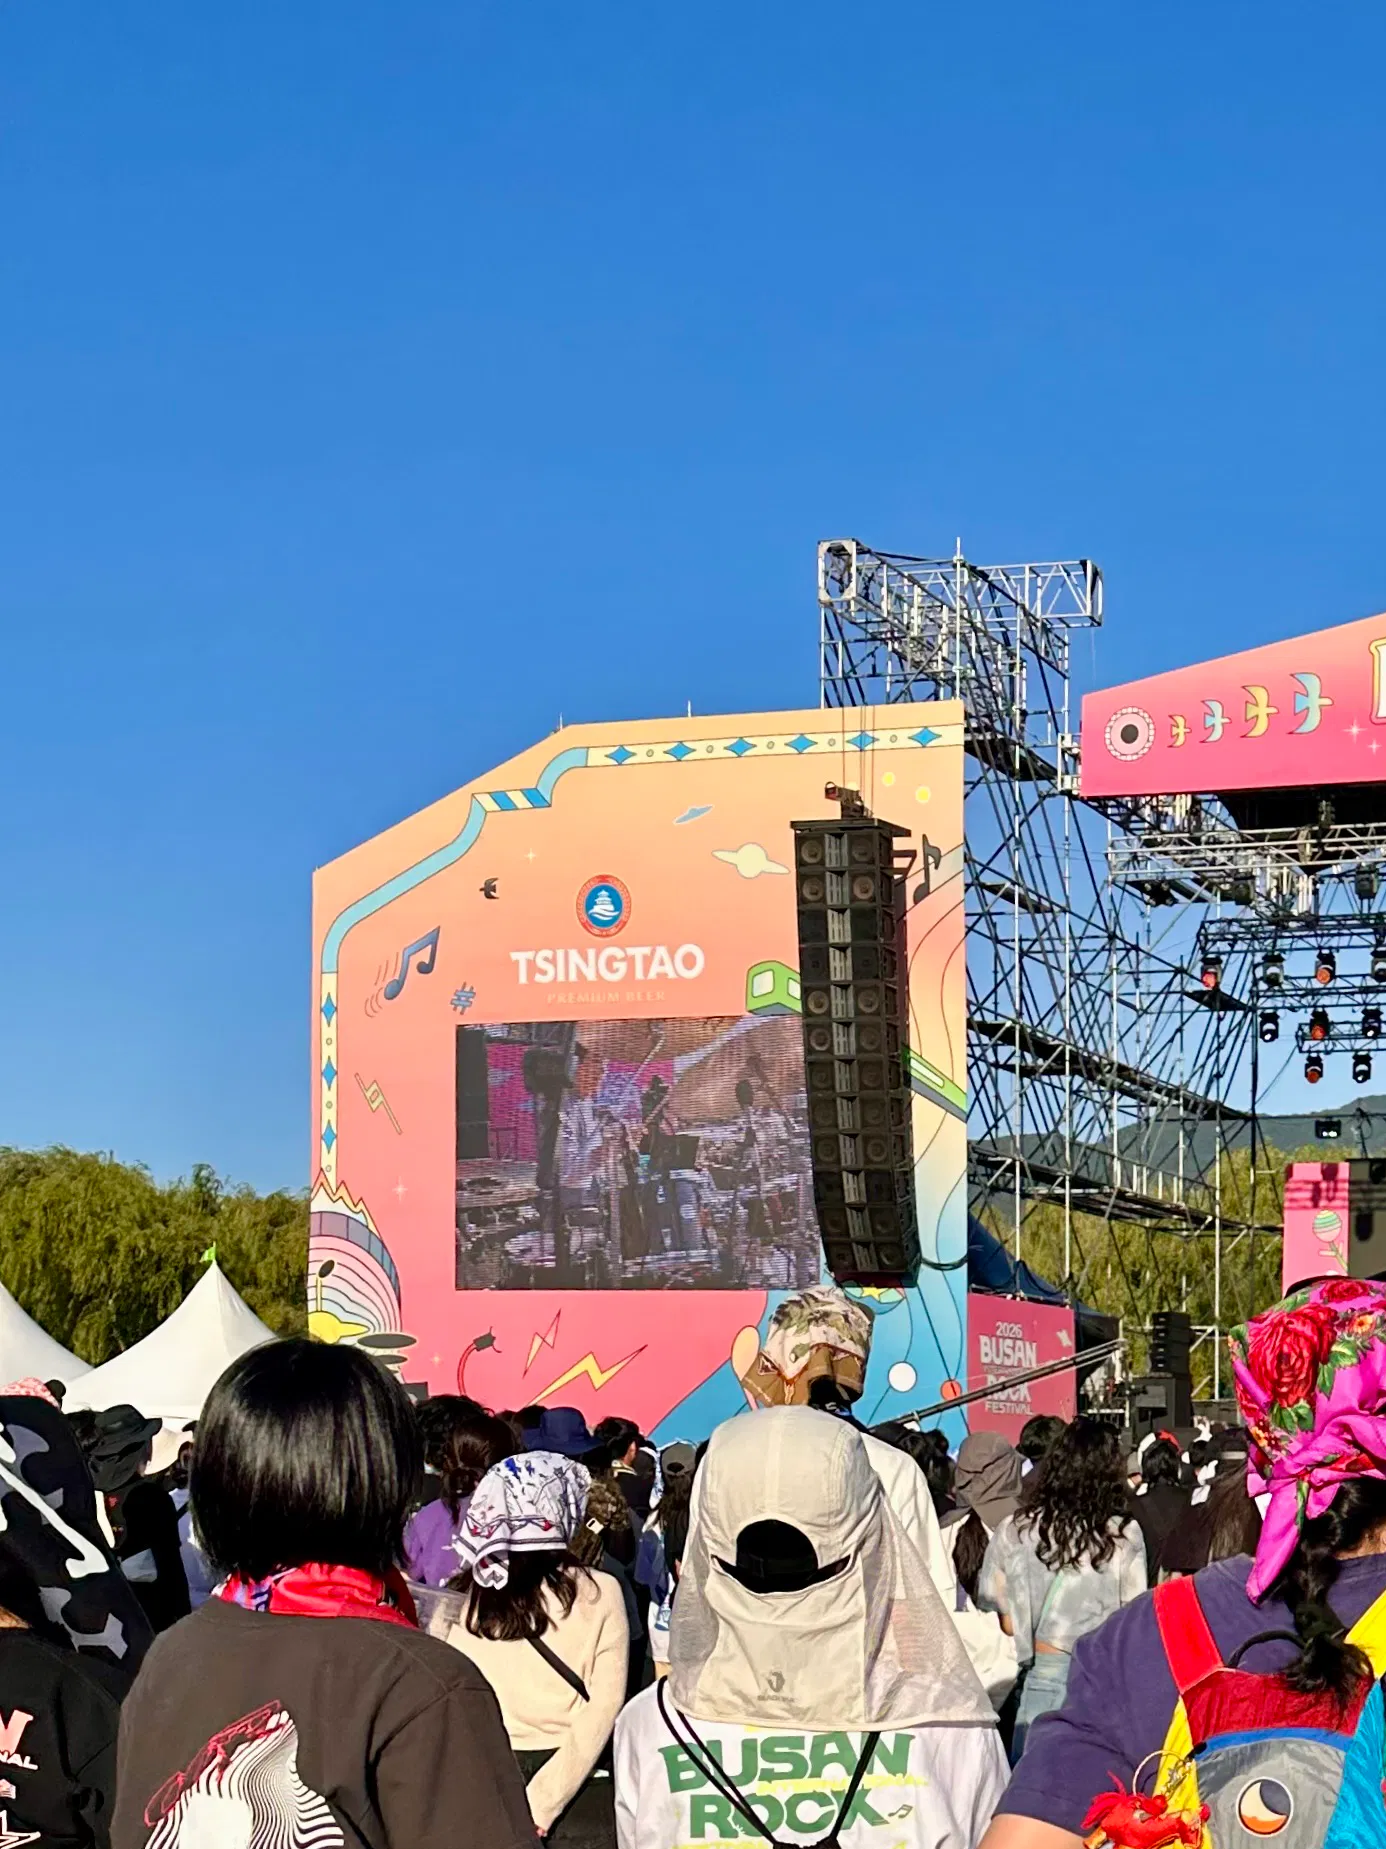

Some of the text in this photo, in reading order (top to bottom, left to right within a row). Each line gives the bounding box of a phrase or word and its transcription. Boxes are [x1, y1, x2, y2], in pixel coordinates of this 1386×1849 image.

[509, 943, 705, 985] TSINGTAO
[547, 991, 665, 1004] PREMIUM BEER
[979, 1334, 1037, 1369] BUSAN
[985, 1401, 1034, 1416] FESTIVAL
[657, 1731, 916, 1793] BUSAN
[690, 1788, 889, 1838] ROCK
